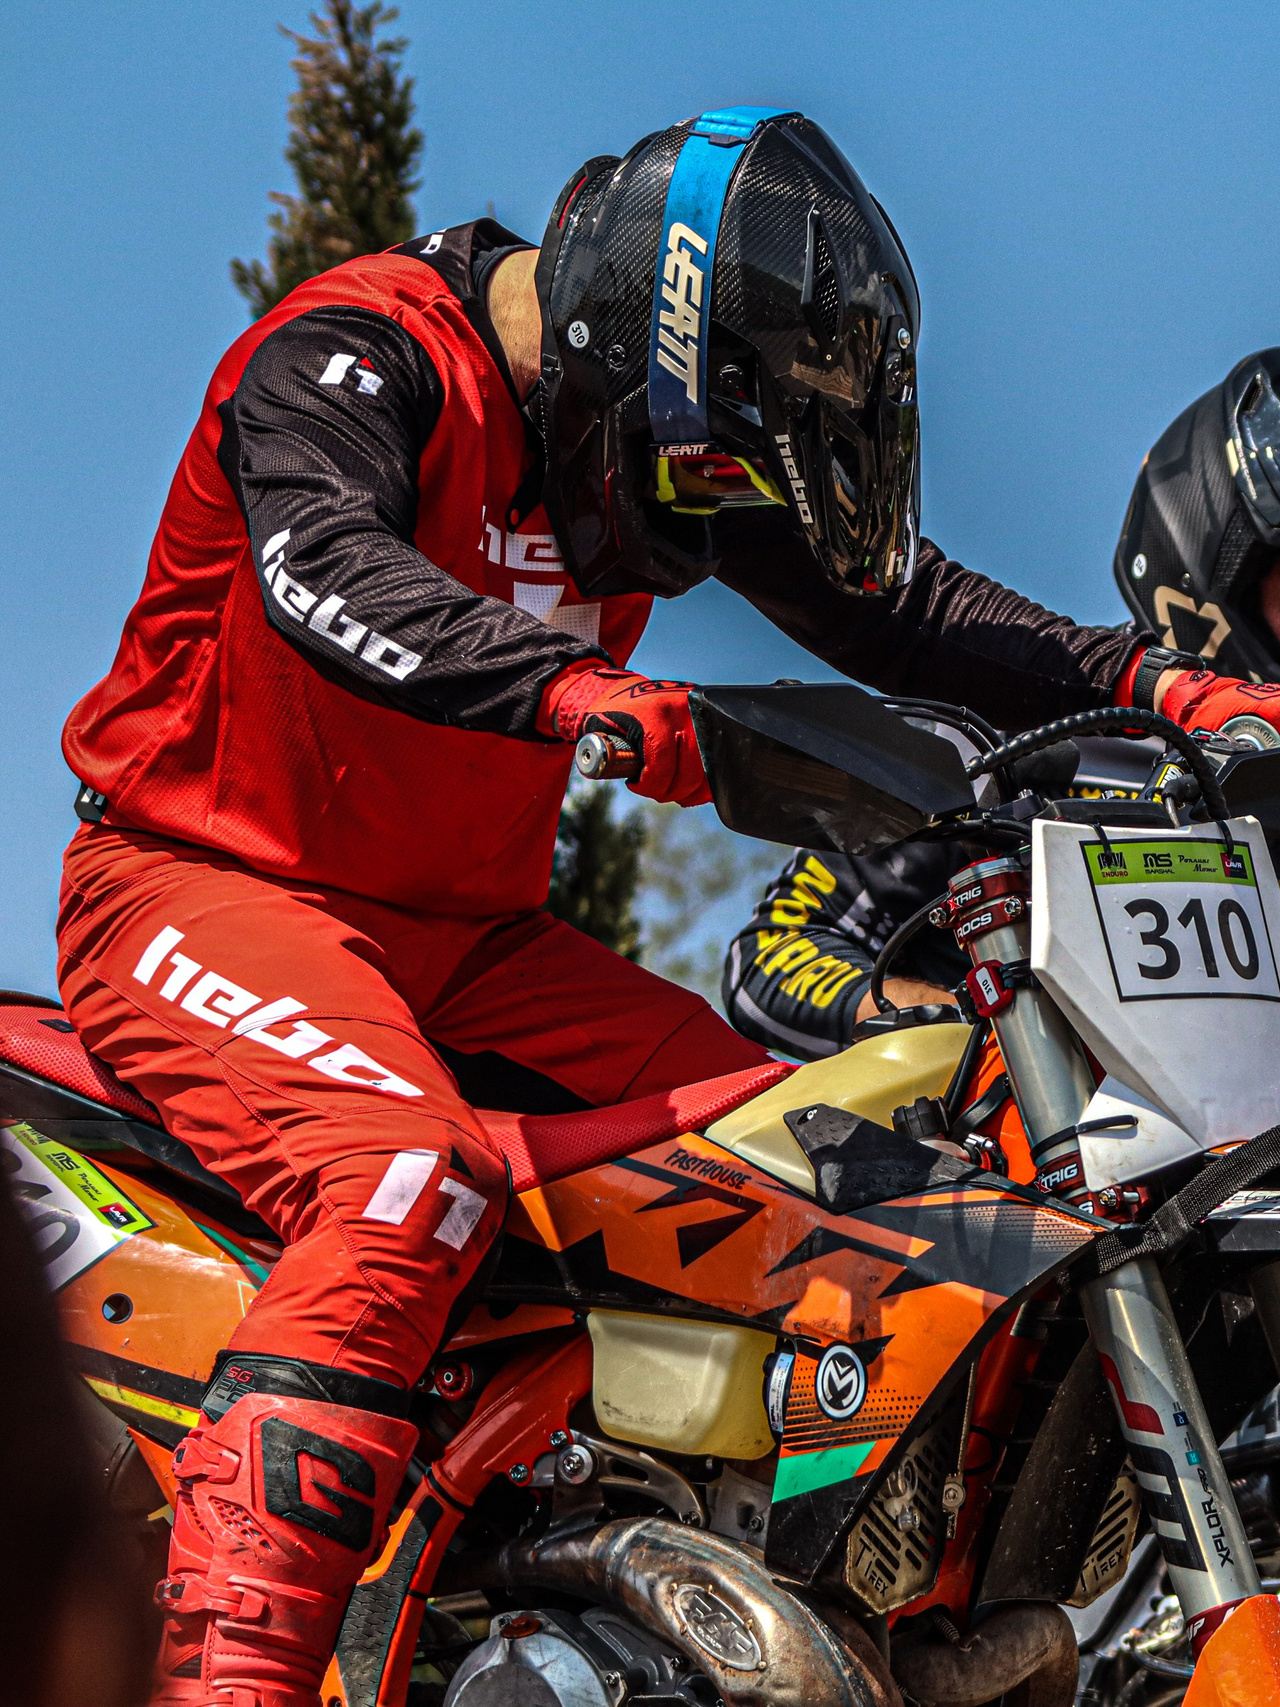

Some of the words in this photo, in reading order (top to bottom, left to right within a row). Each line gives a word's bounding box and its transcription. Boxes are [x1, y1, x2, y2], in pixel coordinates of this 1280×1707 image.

[571, 323, 586, 344] 310
[657, 222, 708, 405] LEATT
[658, 444, 709, 456] LEATT
[775, 434, 814, 524] hebo
[956, 912, 993, 938] ROCS
[1123, 898, 1260, 980] 310
[982, 979, 993, 996] 310
[132, 925, 425, 1097] hebo
[664, 1148, 752, 1190] FASTHOUSE
[226, 1366, 254, 1383] SG
[1201, 1497, 1235, 1568] XPLOR
